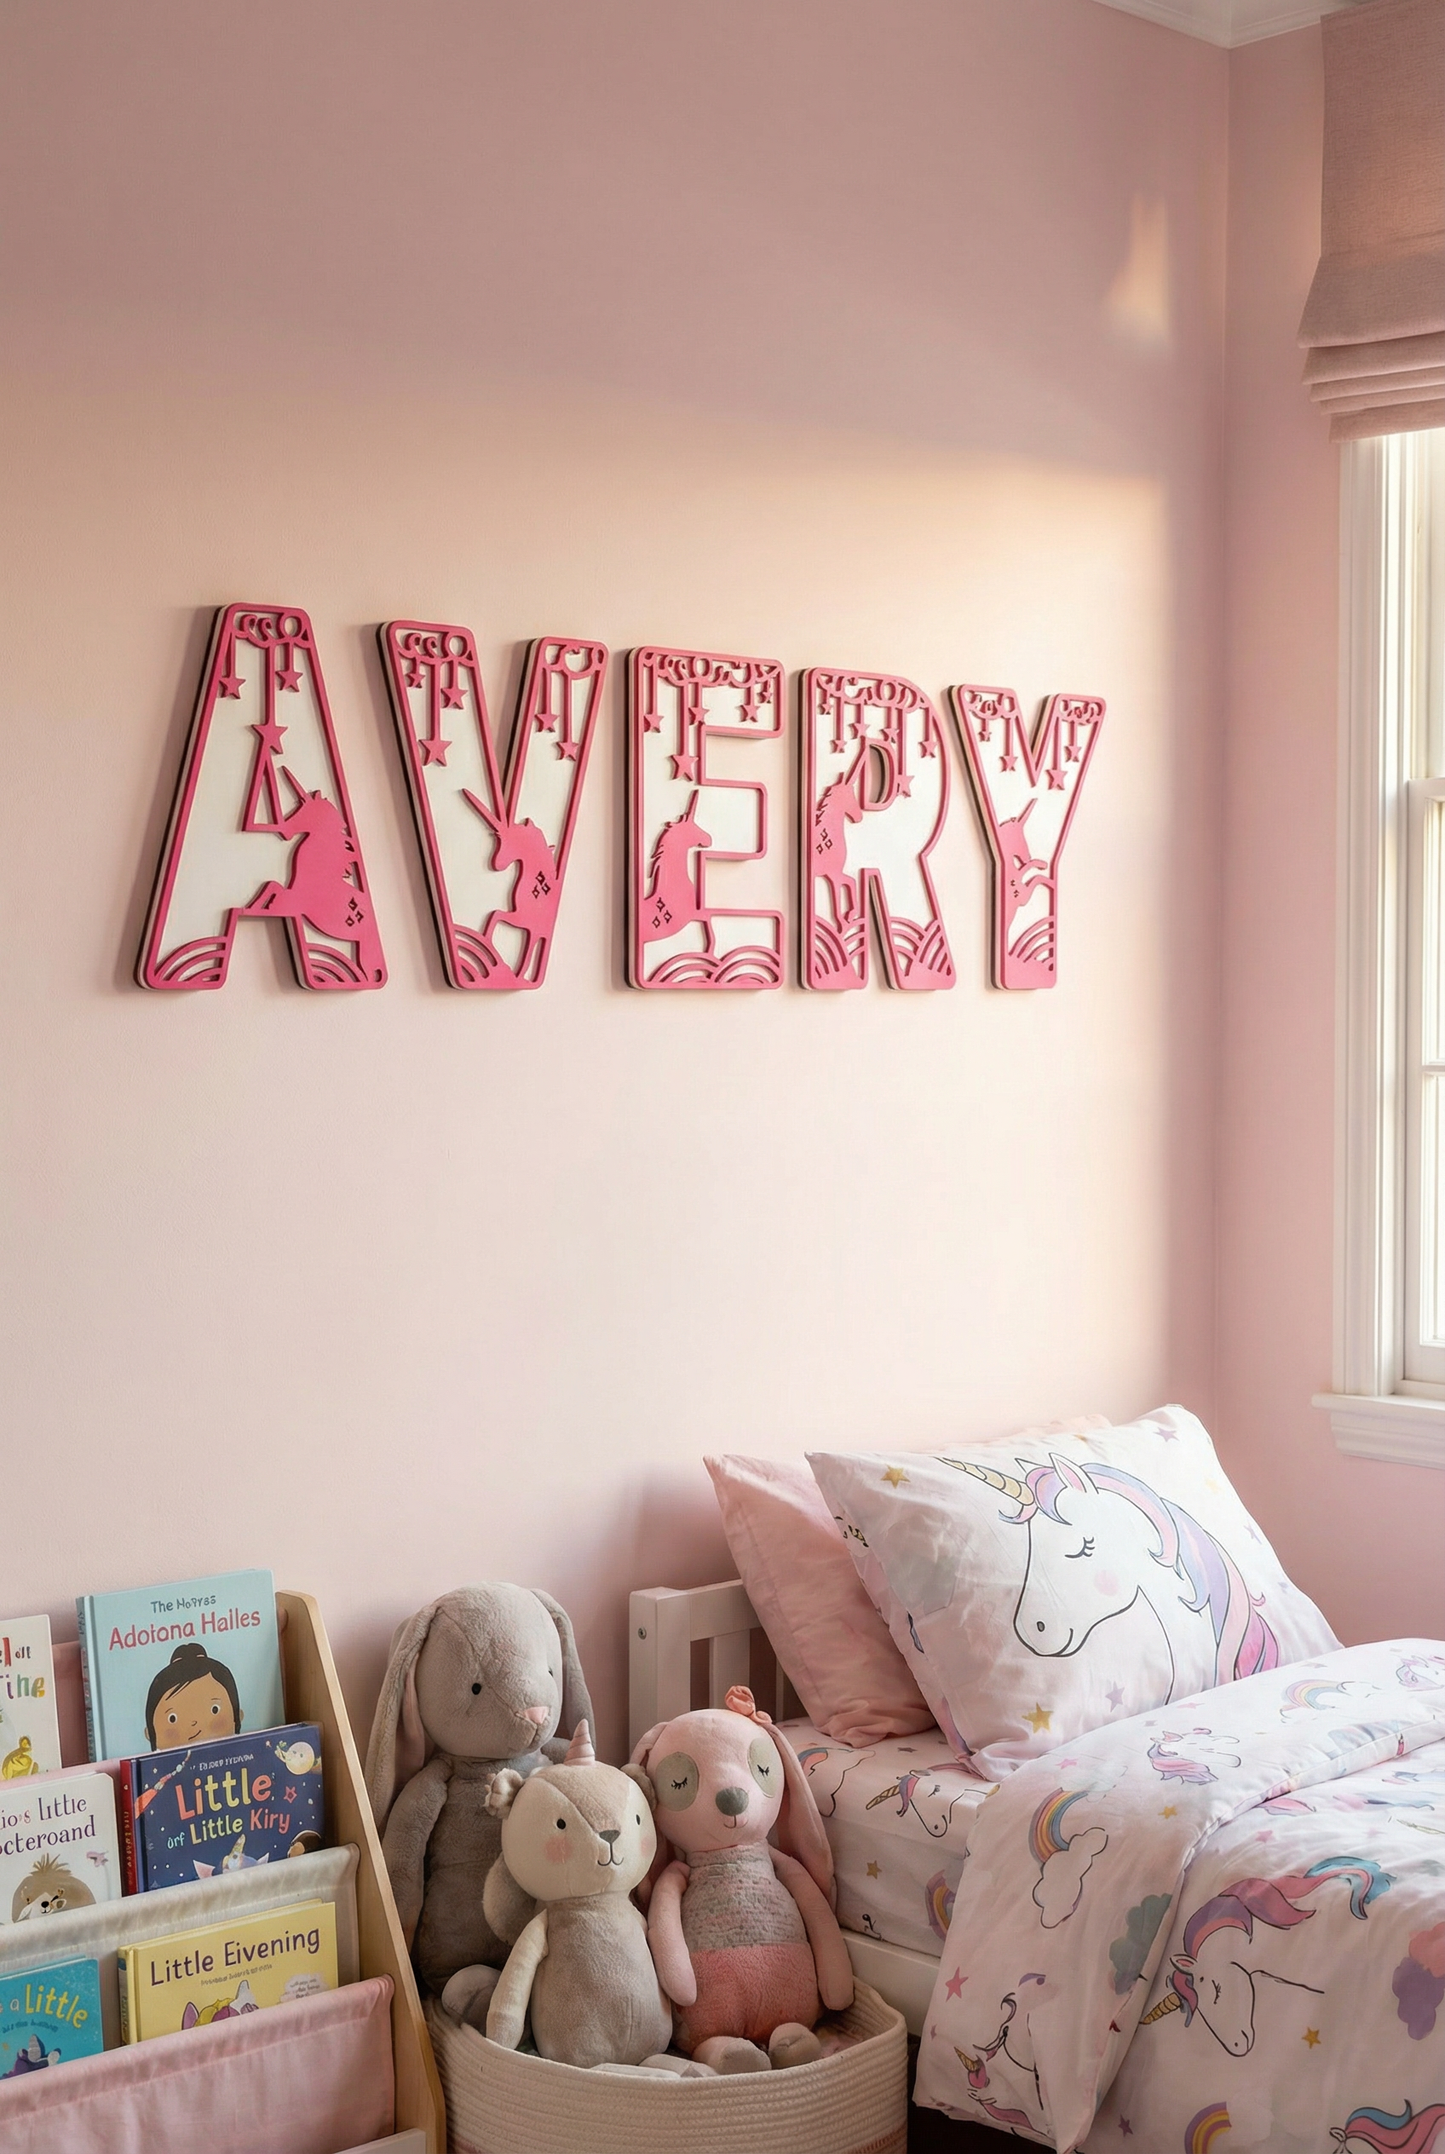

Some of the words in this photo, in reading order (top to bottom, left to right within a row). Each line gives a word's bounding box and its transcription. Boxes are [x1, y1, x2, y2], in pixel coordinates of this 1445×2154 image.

[134, 602, 1106, 990] AVERY
[149, 1601, 174, 1614] The
[175, 1767, 273, 1821] Little
[190, 1814, 244, 1845] Little
[250, 1807, 291, 1835] Kiry
[151, 1950, 214, 1986] Little
[224, 1928, 320, 1967] Eivening
[10, 1998, 20, 2012] a
[25, 1983, 88, 2029] Little
